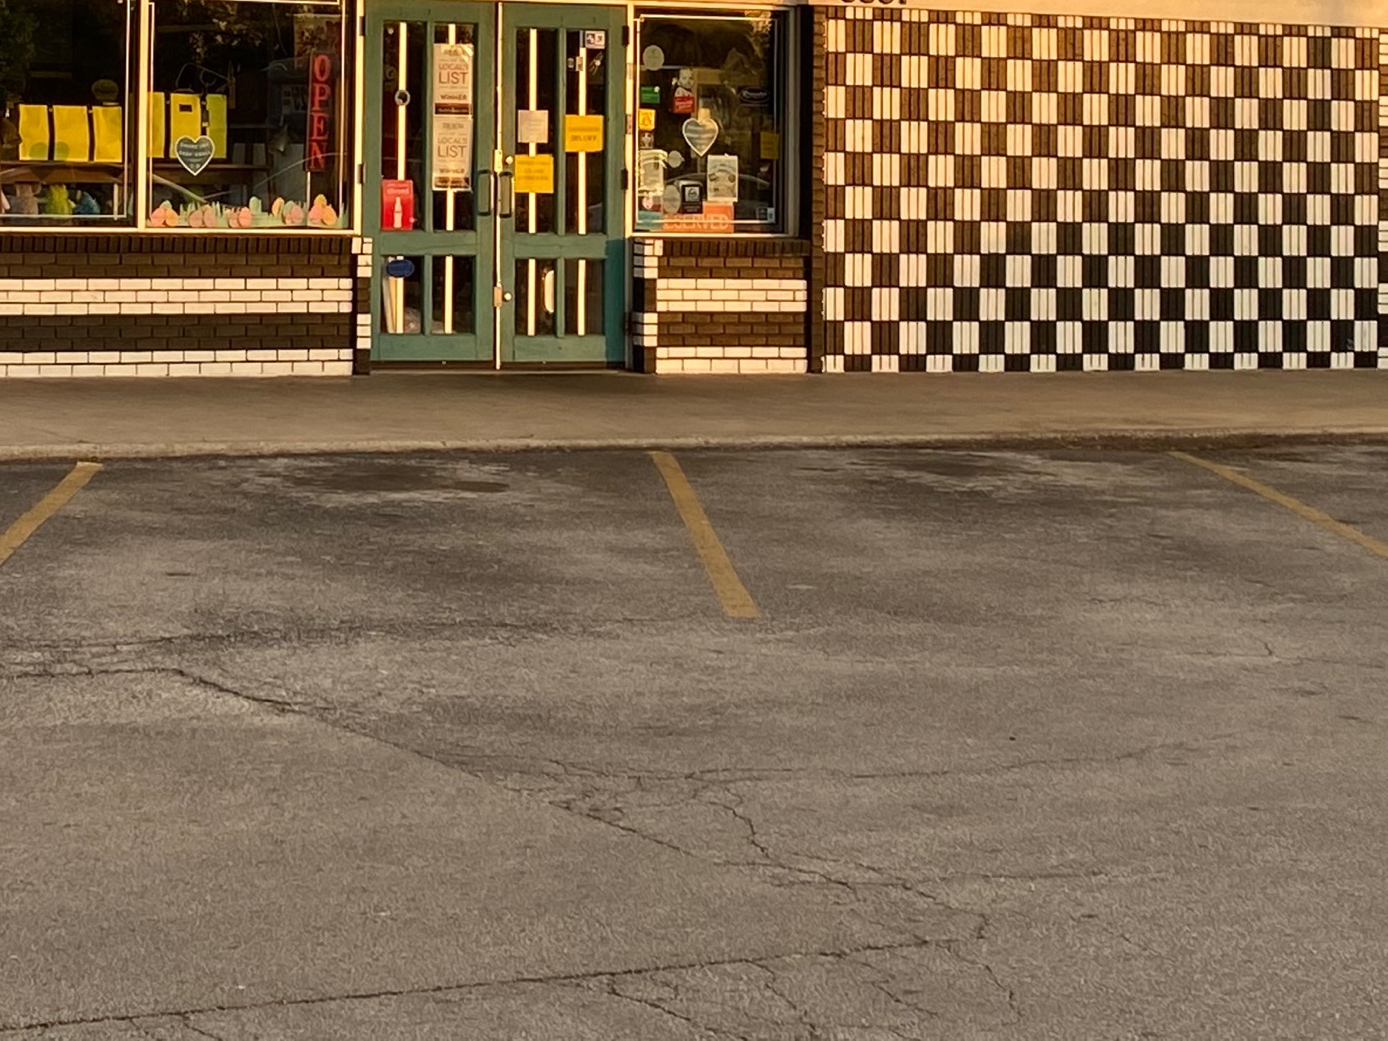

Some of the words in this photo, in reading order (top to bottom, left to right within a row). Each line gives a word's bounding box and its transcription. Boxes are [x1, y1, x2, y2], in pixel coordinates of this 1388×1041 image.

[438, 71, 469, 85] LIST
[309, 54, 331, 169] OPEN
[437, 145, 467, 158] LIST
[663, 213, 729, 230] ESERVED
